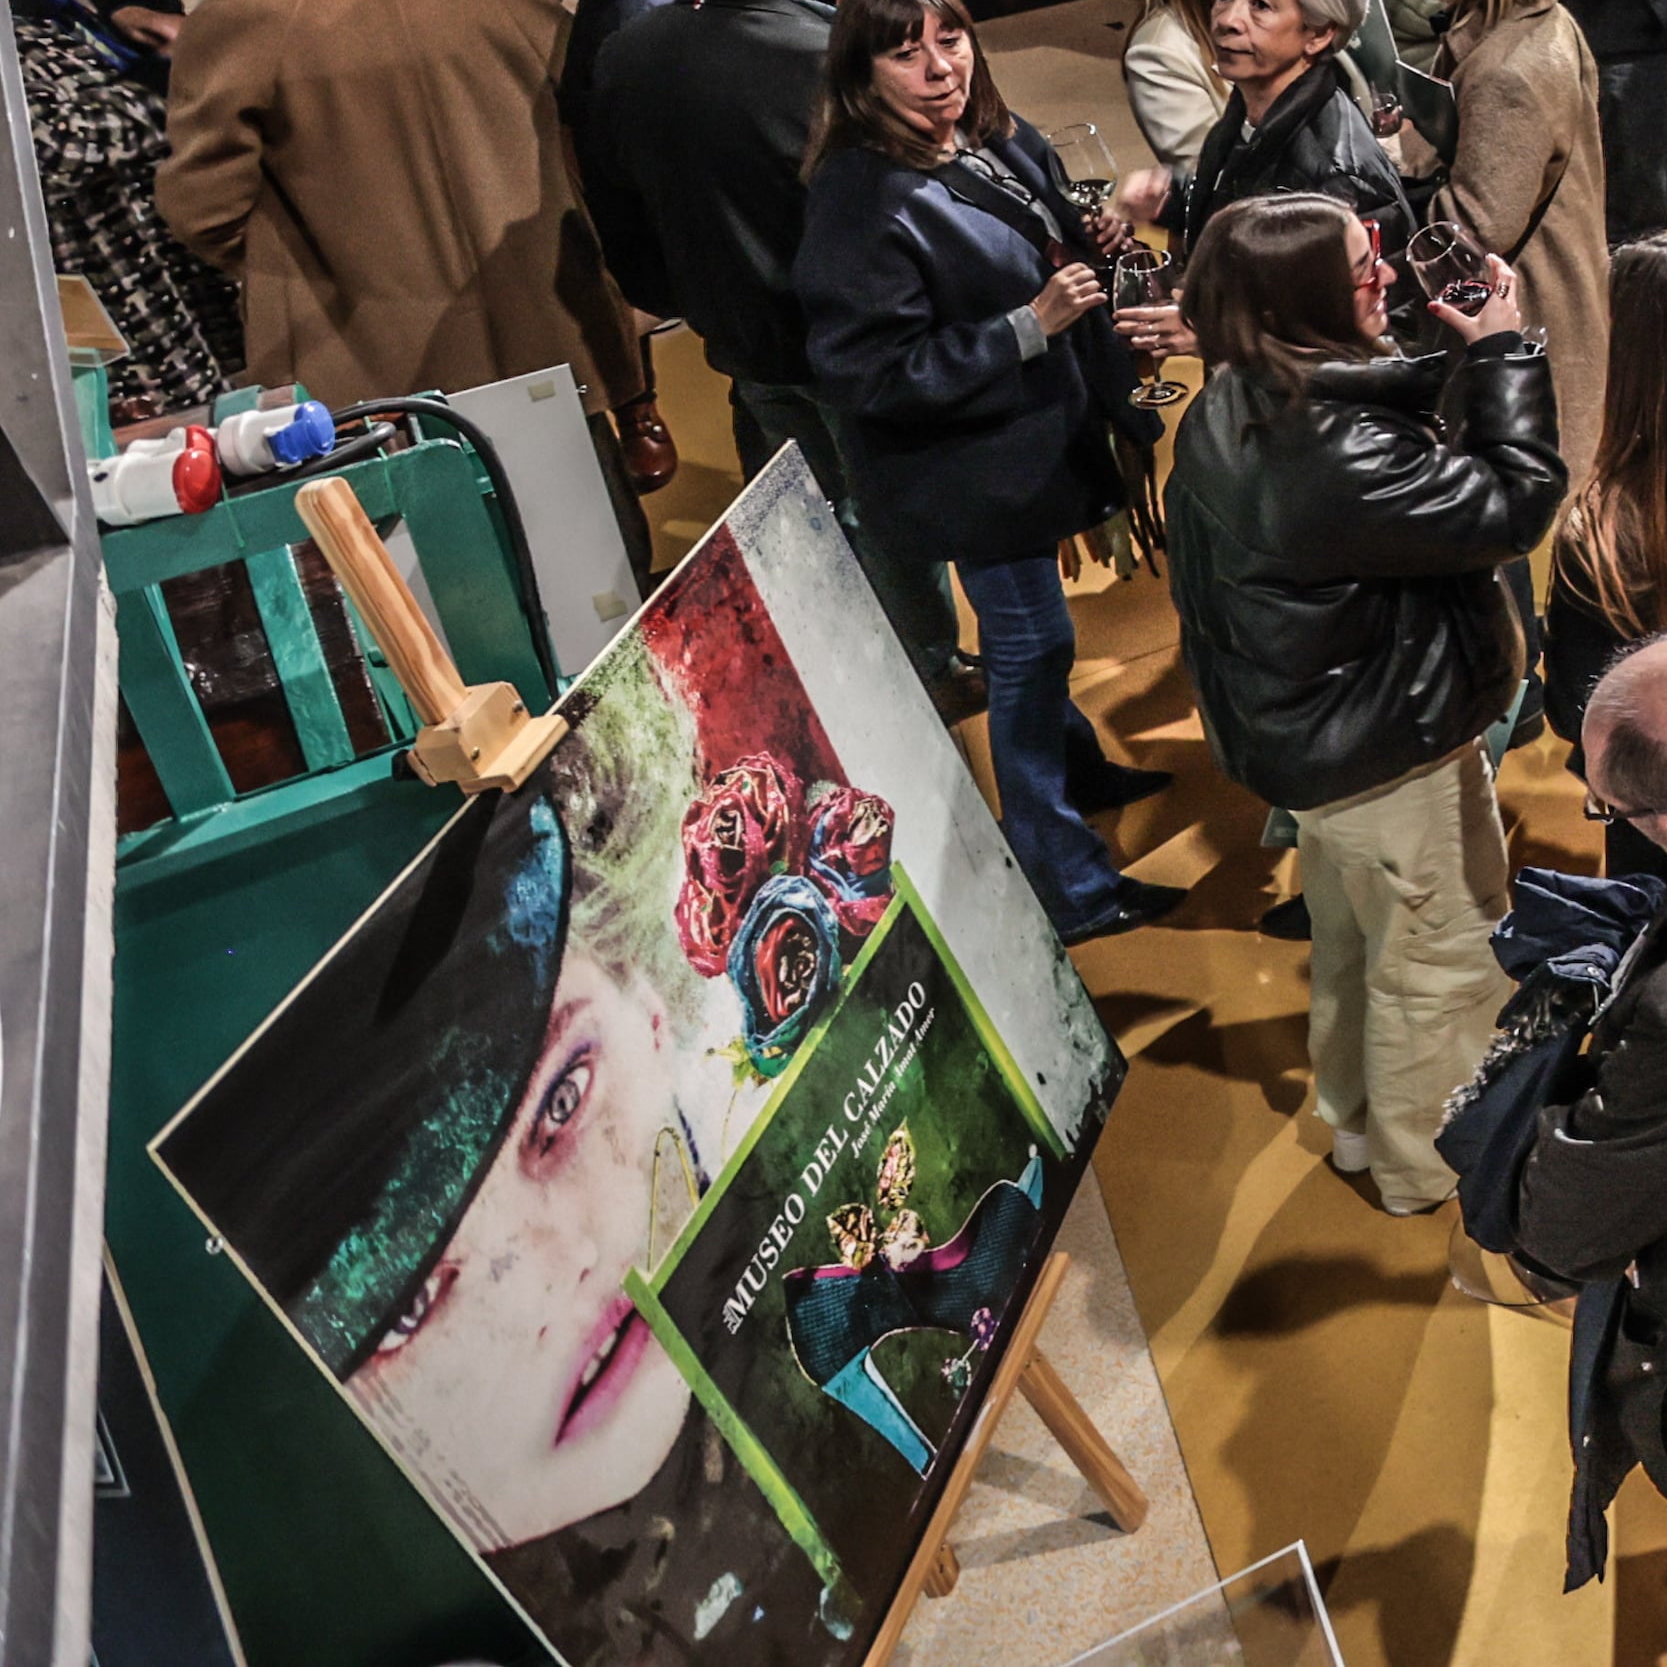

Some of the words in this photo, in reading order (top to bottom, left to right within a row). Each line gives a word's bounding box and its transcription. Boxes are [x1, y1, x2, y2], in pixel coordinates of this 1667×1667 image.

[726, 1192, 806, 1334] MUSEO
[800, 1124, 849, 1199] DEL
[843, 981, 926, 1122] CALZADO
[850, 1120, 871, 1159] José
